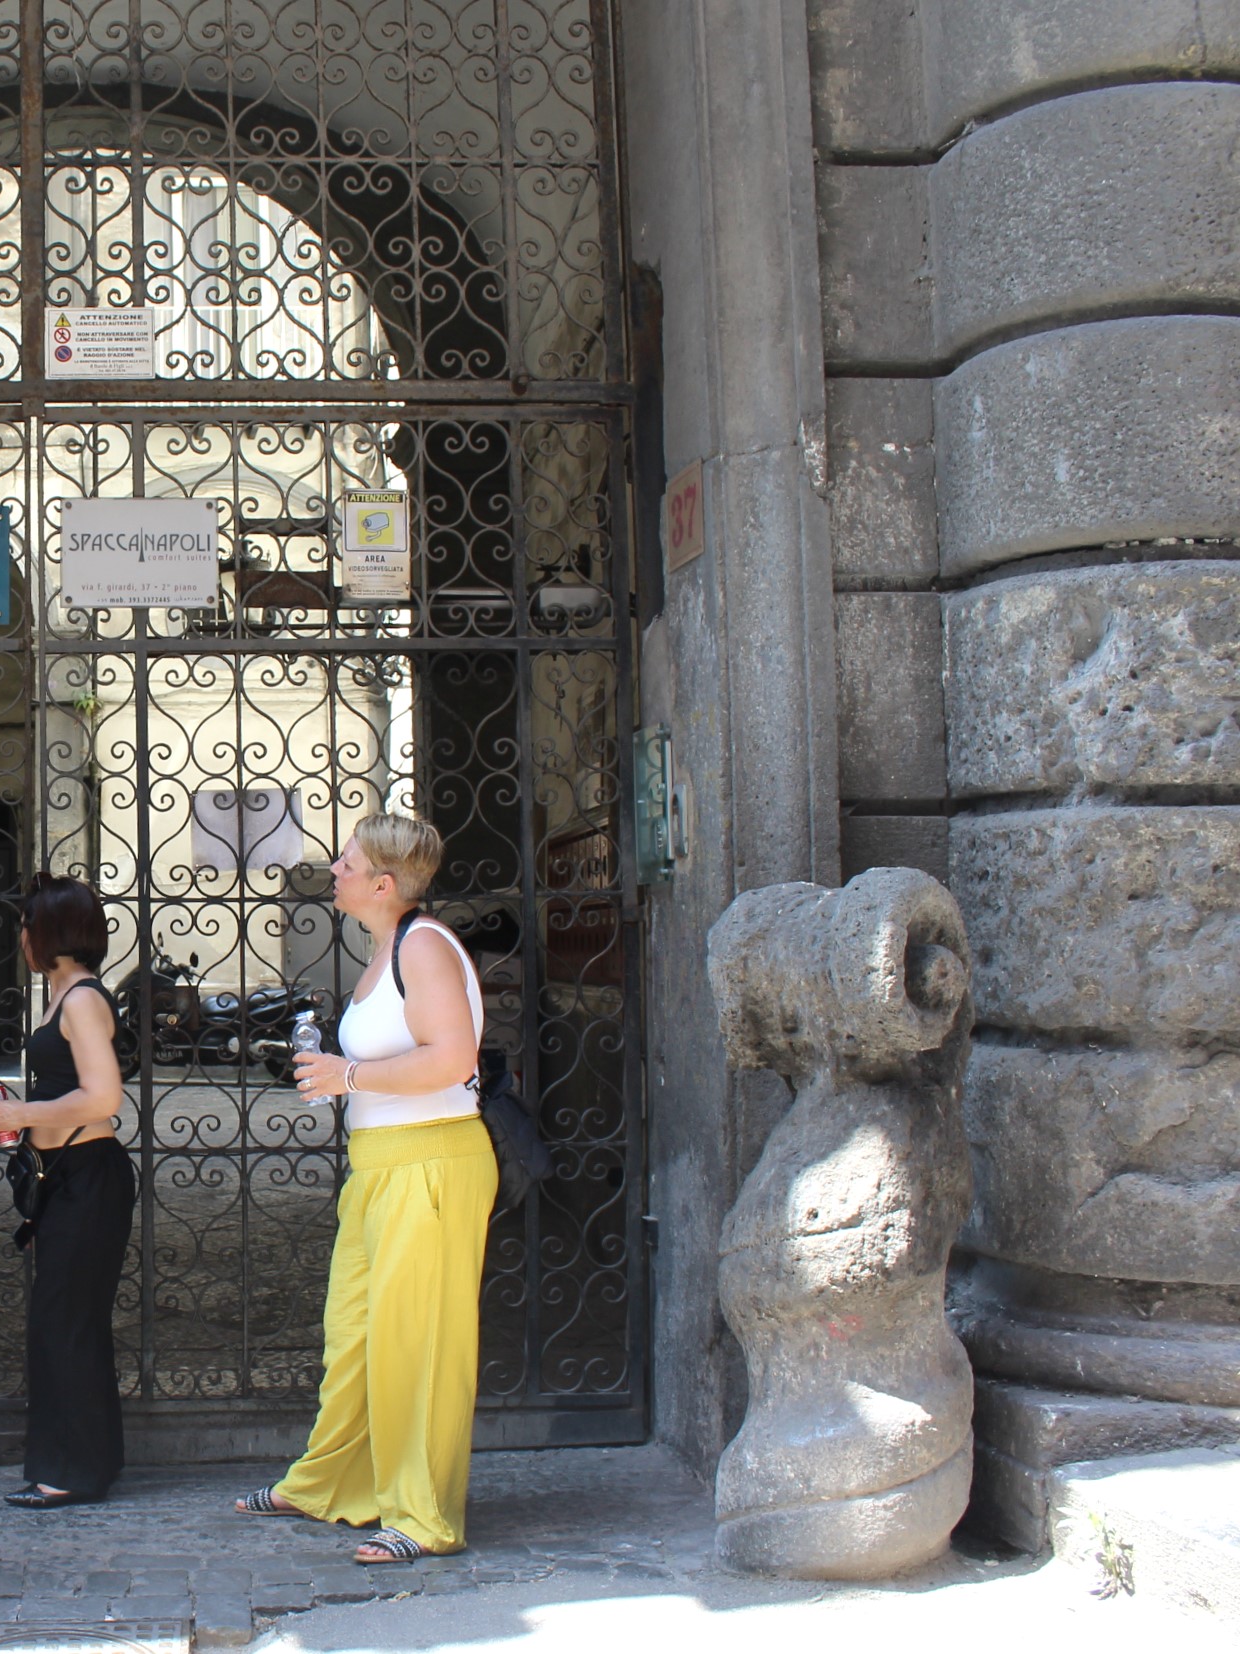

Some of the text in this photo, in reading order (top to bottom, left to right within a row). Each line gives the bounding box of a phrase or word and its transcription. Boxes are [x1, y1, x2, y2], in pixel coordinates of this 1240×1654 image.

[349, 493, 401, 502] ATTENZIONE
[671, 483, 697, 549] 37
[148, 553, 212, 561] comfort suites
[364, 555, 386, 563] AREA
[81, 583, 94, 591] via
[98, 583, 104, 591] f.
[107, 583, 138, 593] girardi,
[141, 583, 151, 591] 37
[174, 583, 198, 593] piano
